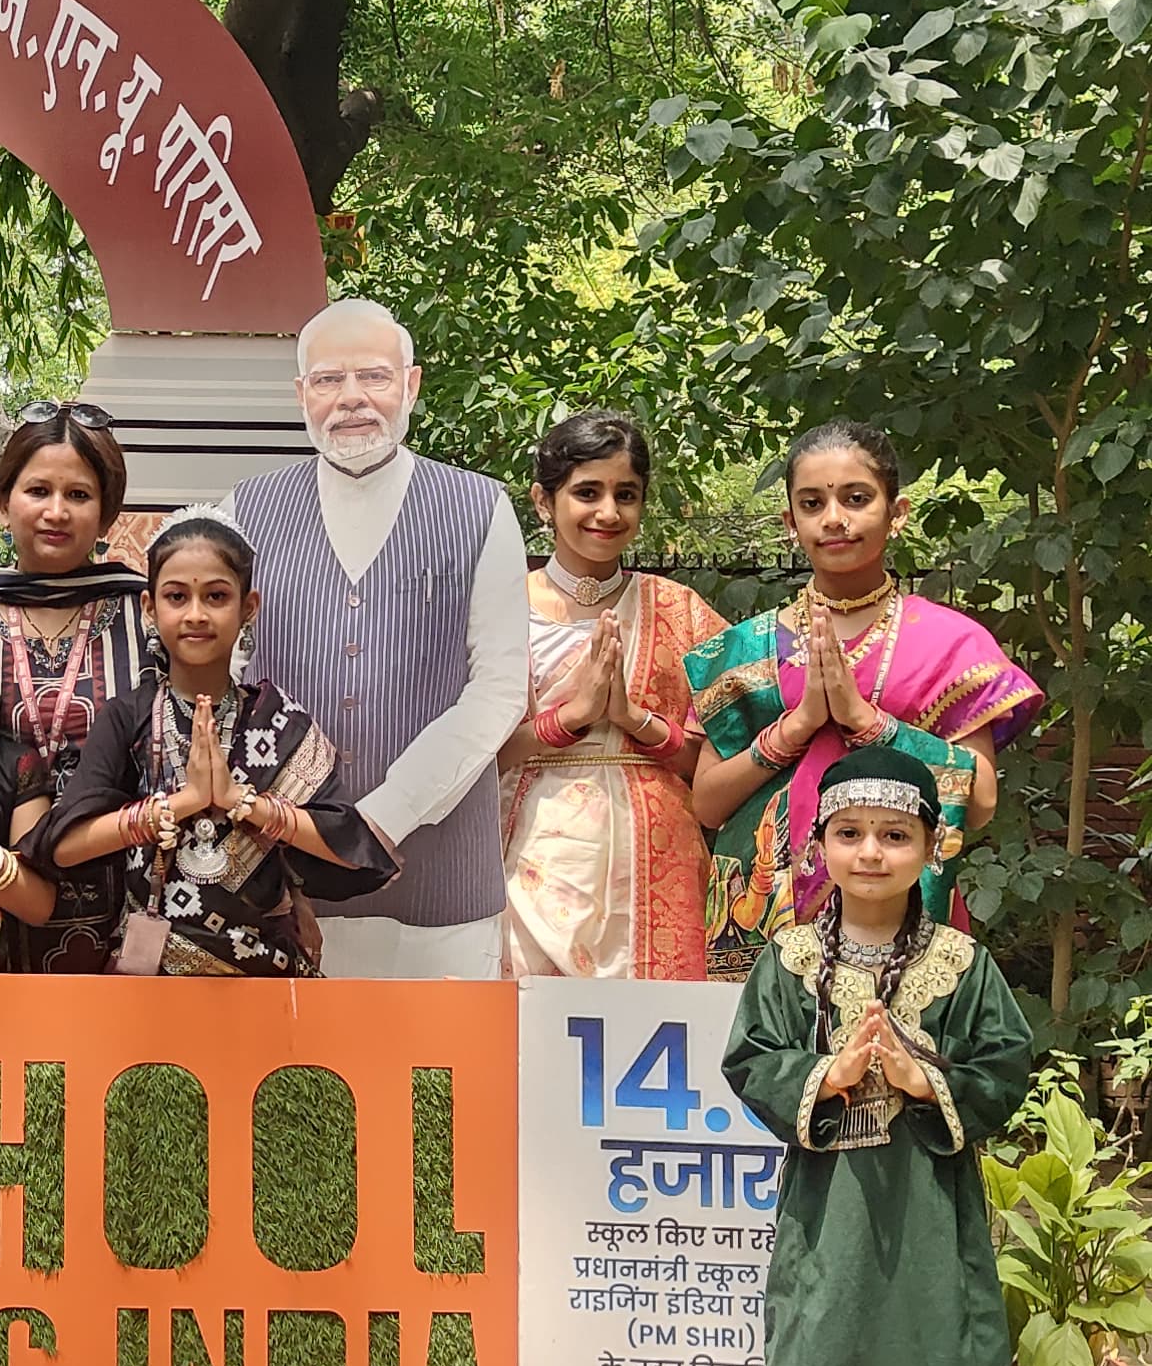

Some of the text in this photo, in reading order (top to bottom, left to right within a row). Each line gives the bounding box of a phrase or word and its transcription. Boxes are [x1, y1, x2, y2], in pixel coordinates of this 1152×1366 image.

[153, 103, 263, 302] परिसर
[567, 1017, 770, 1133] 14.
[600, 1138, 785, 1213] हजार
[585, 1221, 650, 1252] स्कूल
[655, 1217, 706, 1247] किए
[712, 1226, 744, 1250] जा
[573, 1254, 761, 1292] प्रधानमंत्री स्कूल
[568, 1283, 659, 1314] राइजिंग
[665, 1287, 734, 1316] इंडिया
[628, 1317, 756, 1354] (PM SHRI)
